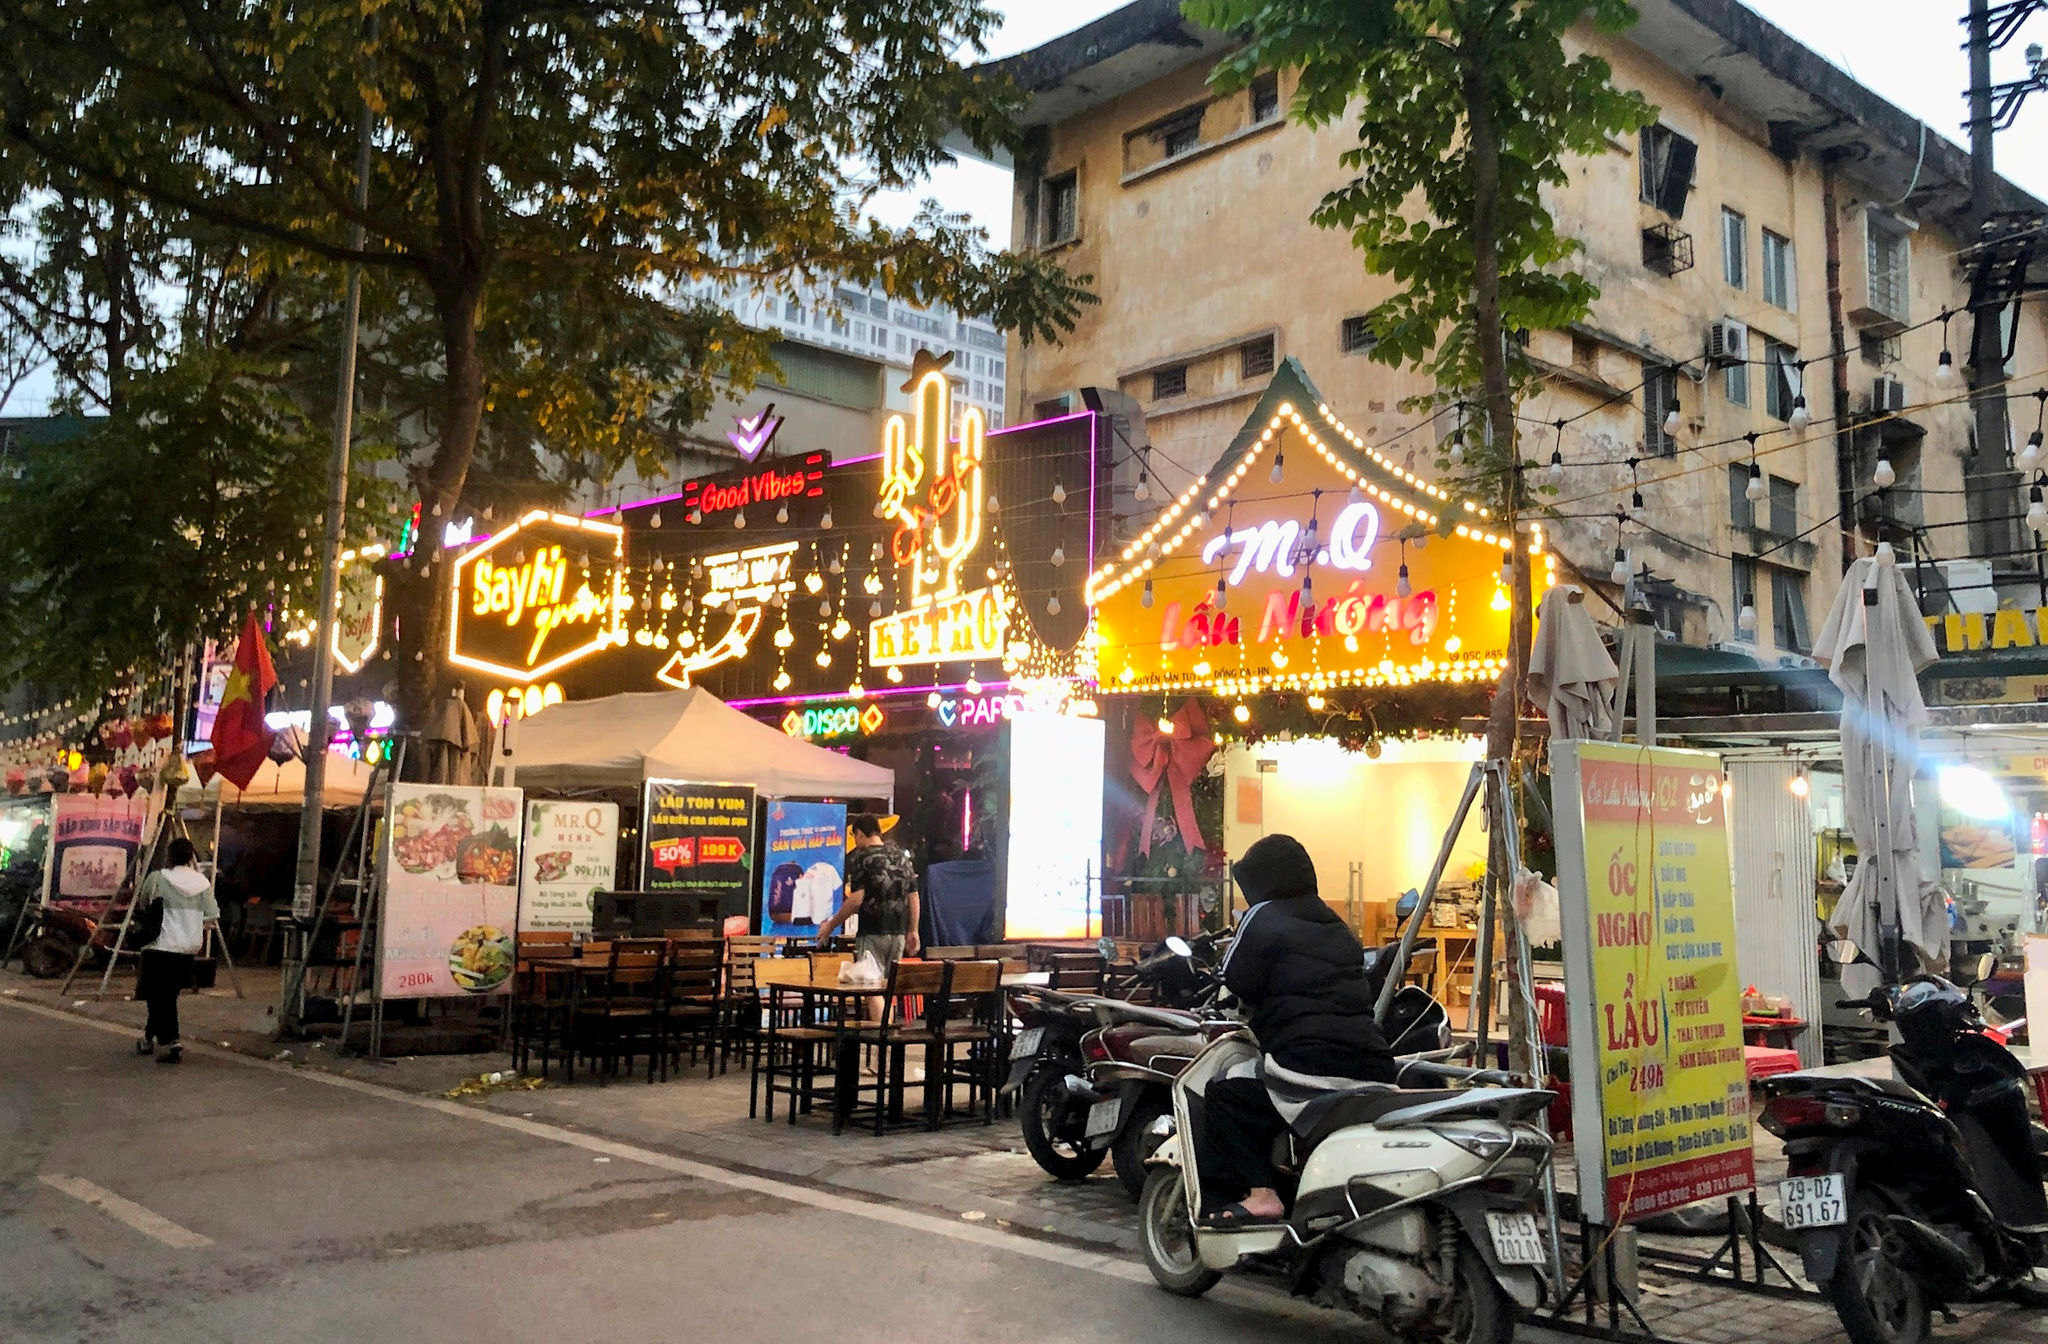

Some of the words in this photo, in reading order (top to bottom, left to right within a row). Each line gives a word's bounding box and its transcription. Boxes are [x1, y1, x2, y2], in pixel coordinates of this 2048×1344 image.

[701, 477, 749, 514] Good
[752, 470, 805, 502] Vibes
[874, 593, 998, 658] RETRO
[1257, 577, 1439, 645] Nướng
[803, 706, 860, 737] DISCO
[660, 793, 684, 809] LẨU
[687, 796, 715, 810] TOM
[717, 797, 746, 811] YUM
[557, 833, 592, 843] MENU
[659, 844, 692, 862] 50%
[1608, 846, 1637, 896] ỐC
[1597, 911, 1652, 948] NGAO
[398, 972, 435, 989] 280k
[1605, 972, 1659, 1051] LẨU
[1786, 1200, 1841, 1228] 691.67
